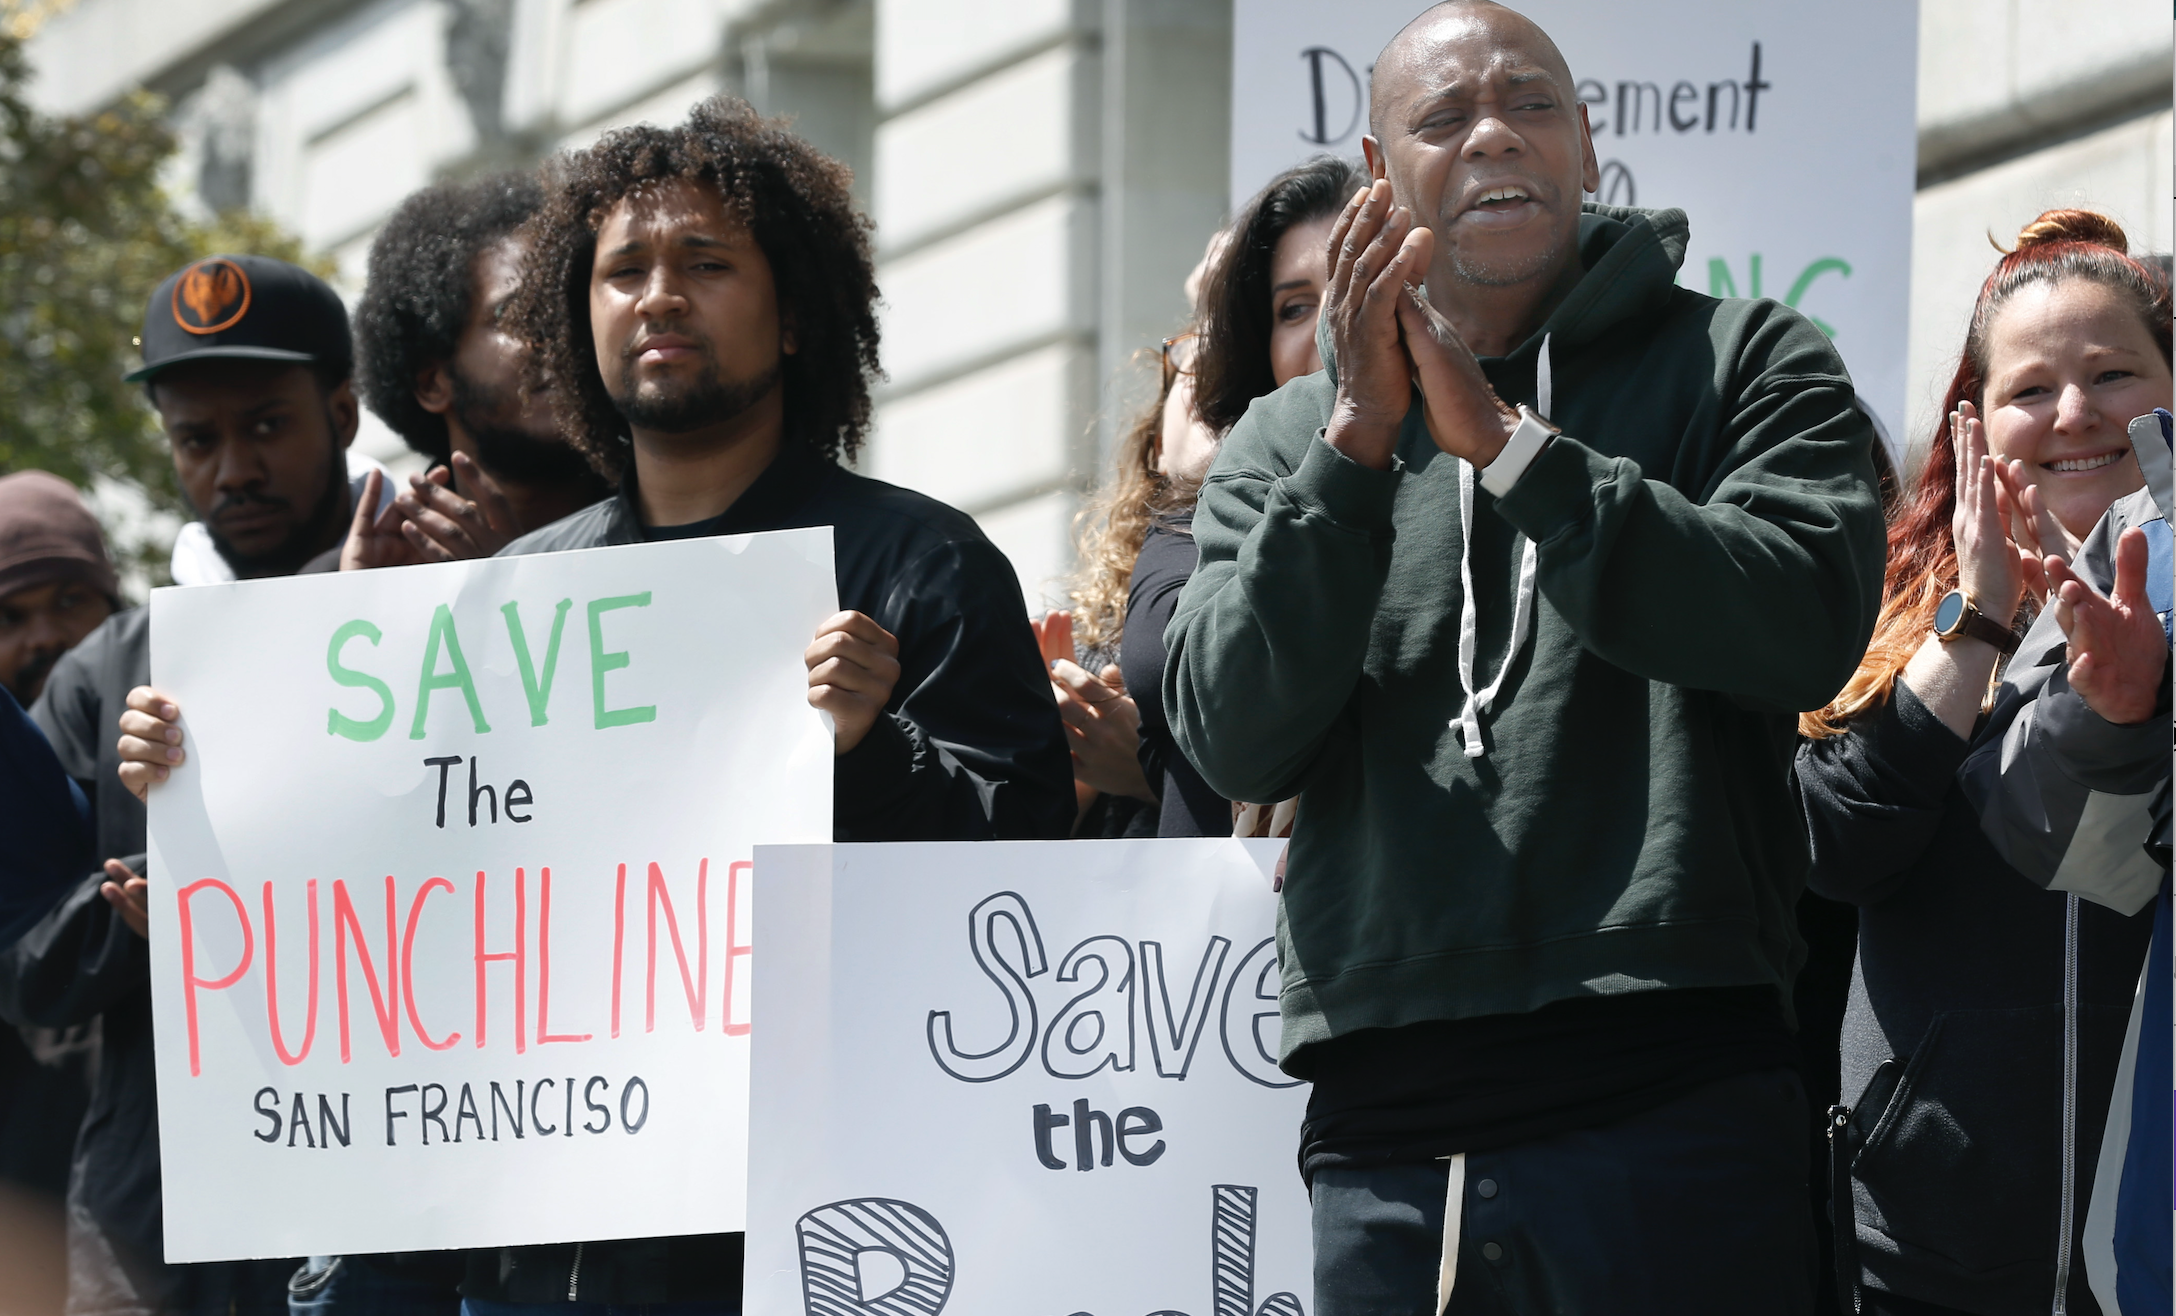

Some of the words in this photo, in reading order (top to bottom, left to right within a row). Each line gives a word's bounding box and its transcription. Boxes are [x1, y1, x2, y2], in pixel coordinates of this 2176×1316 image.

[326, 591, 657, 742] SAVE
[424, 755, 534, 828] The
[176, 857, 753, 1077] PUNCHLINE
[927, 890, 1312, 1088] Save
[253, 1086, 351, 1149] SAN
[385, 1076, 650, 1147] FRANCISO
[1033, 1098, 1166, 1172] the
